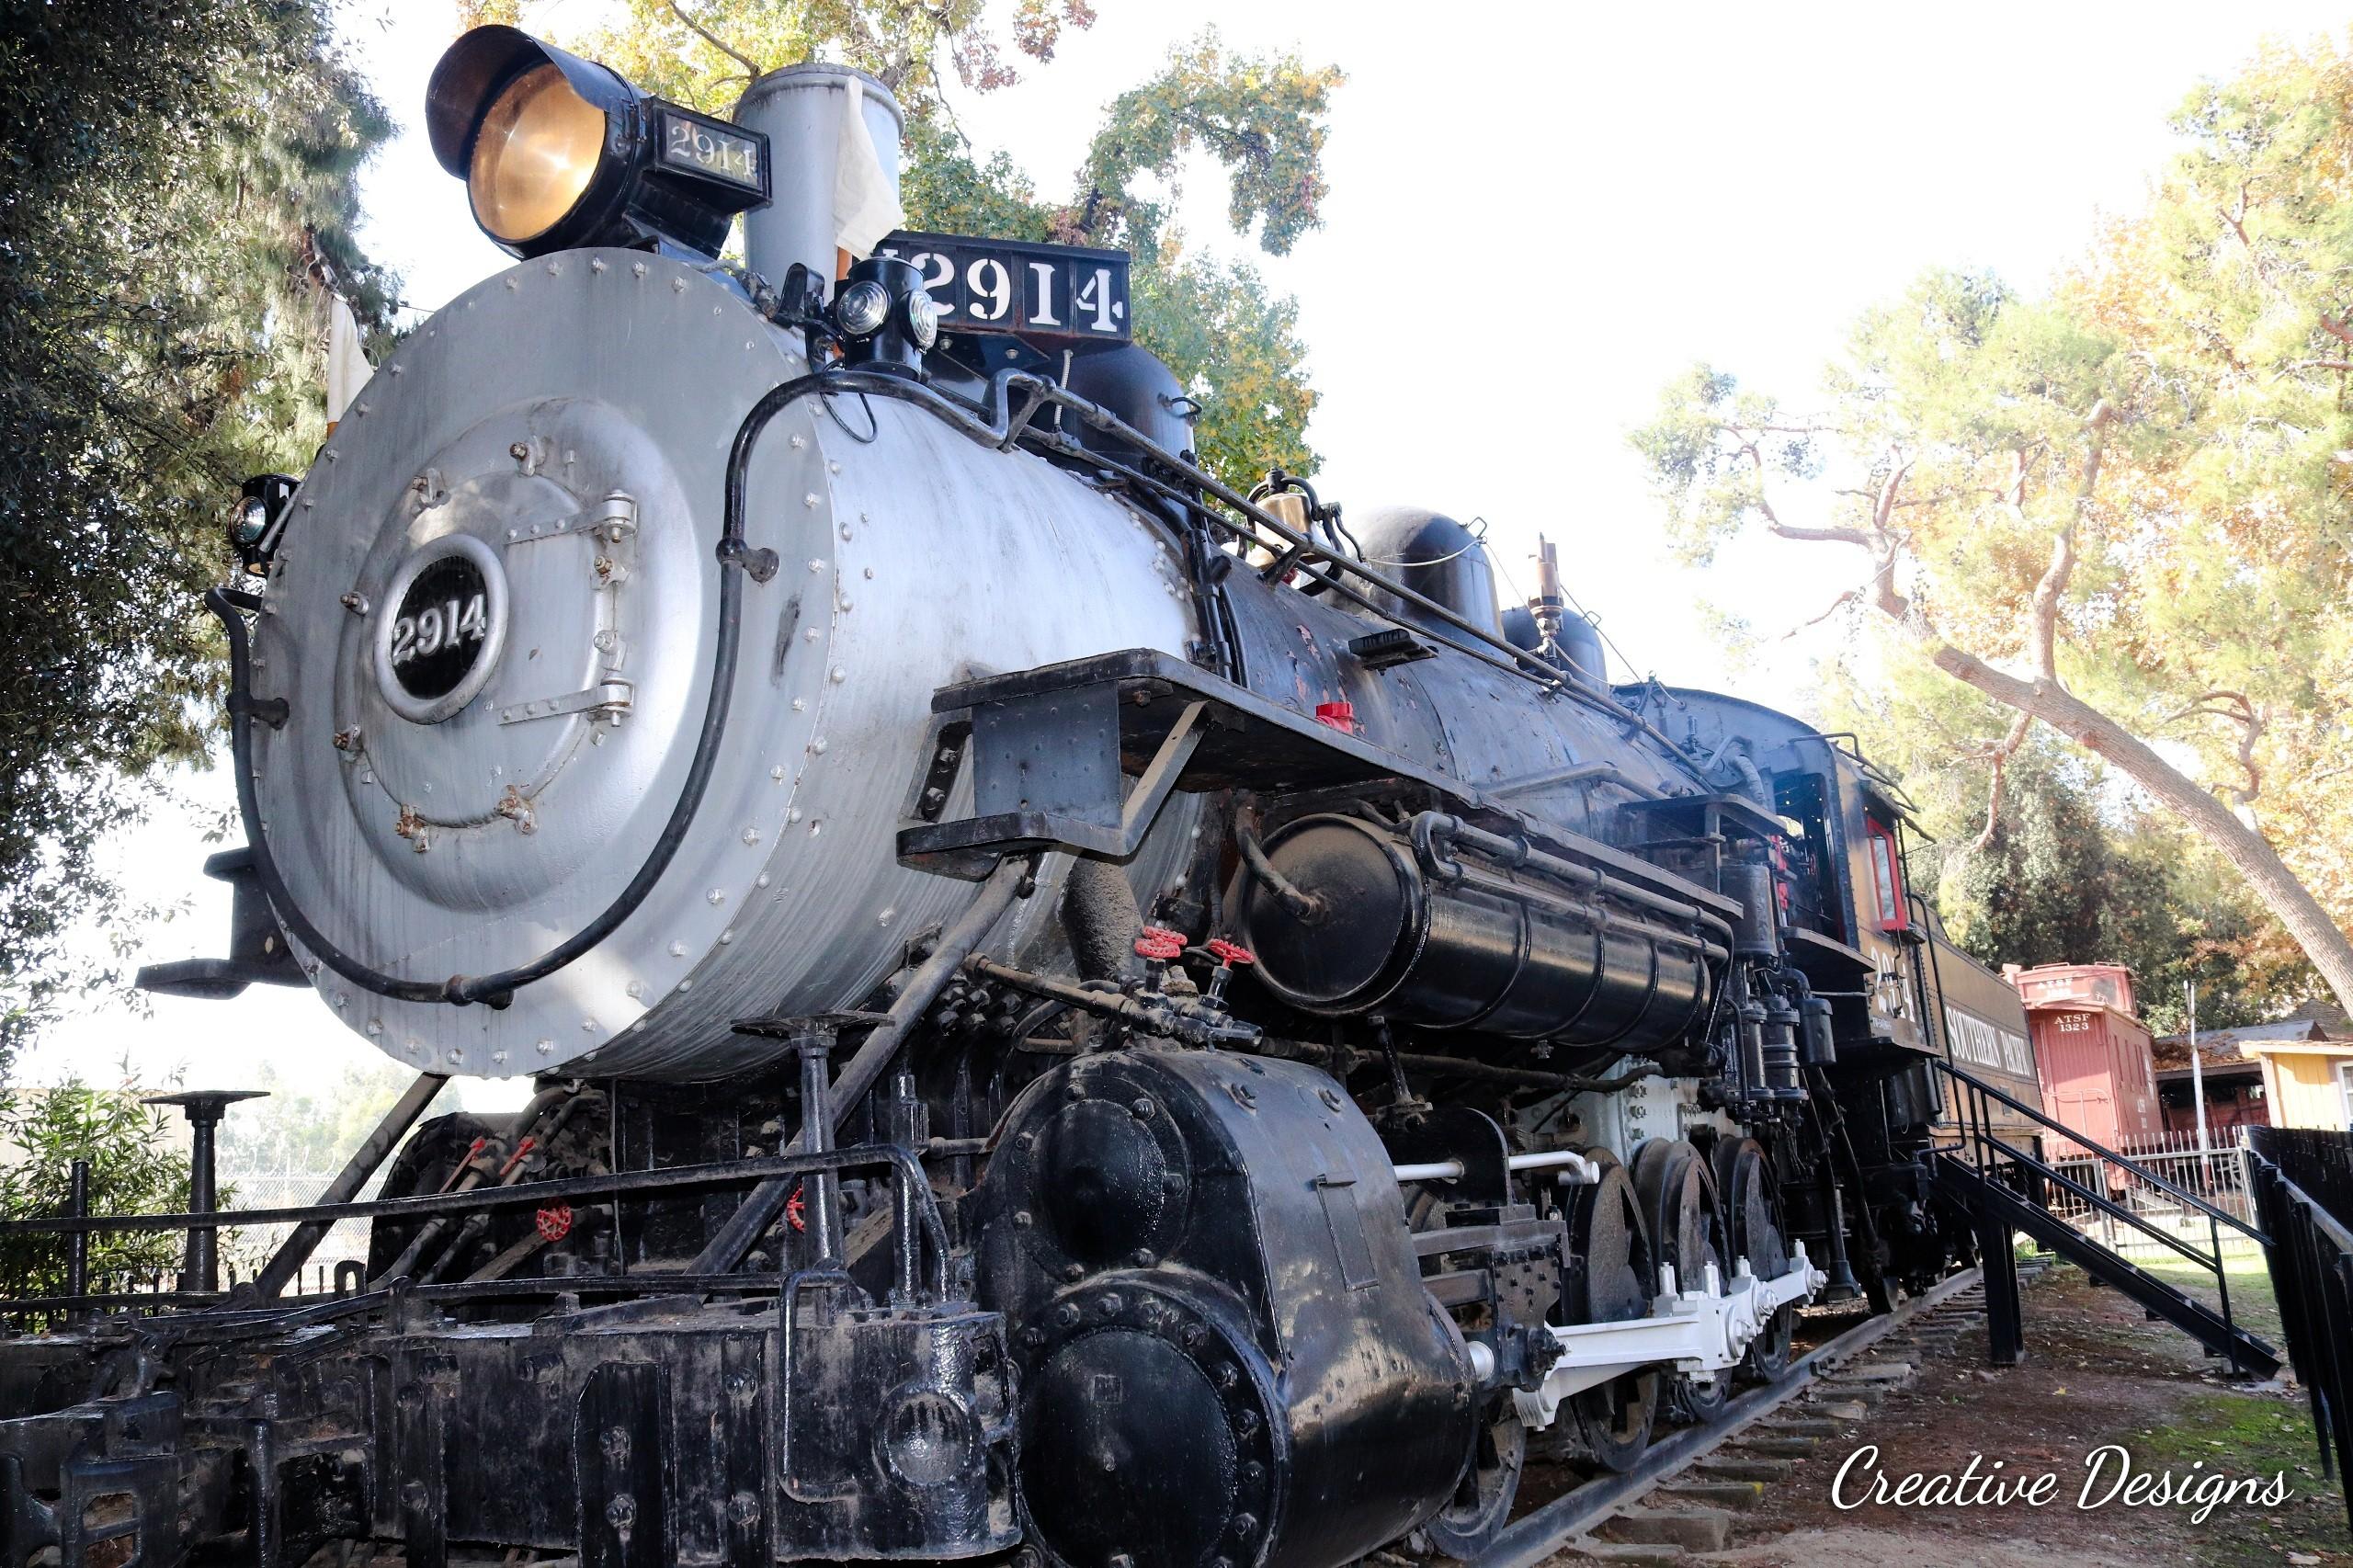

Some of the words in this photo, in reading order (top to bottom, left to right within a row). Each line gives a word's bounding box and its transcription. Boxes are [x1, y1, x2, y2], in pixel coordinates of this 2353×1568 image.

[671, 125, 757, 177] 2914
[882, 248, 1123, 333] 2914
[392, 594, 486, 666] 2914
[1946, 1006, 2002, 1069] SOUTHERN
[2053, 1013, 2091, 1025] ATSF
[2060, 1022, 2089, 1032] 1323
